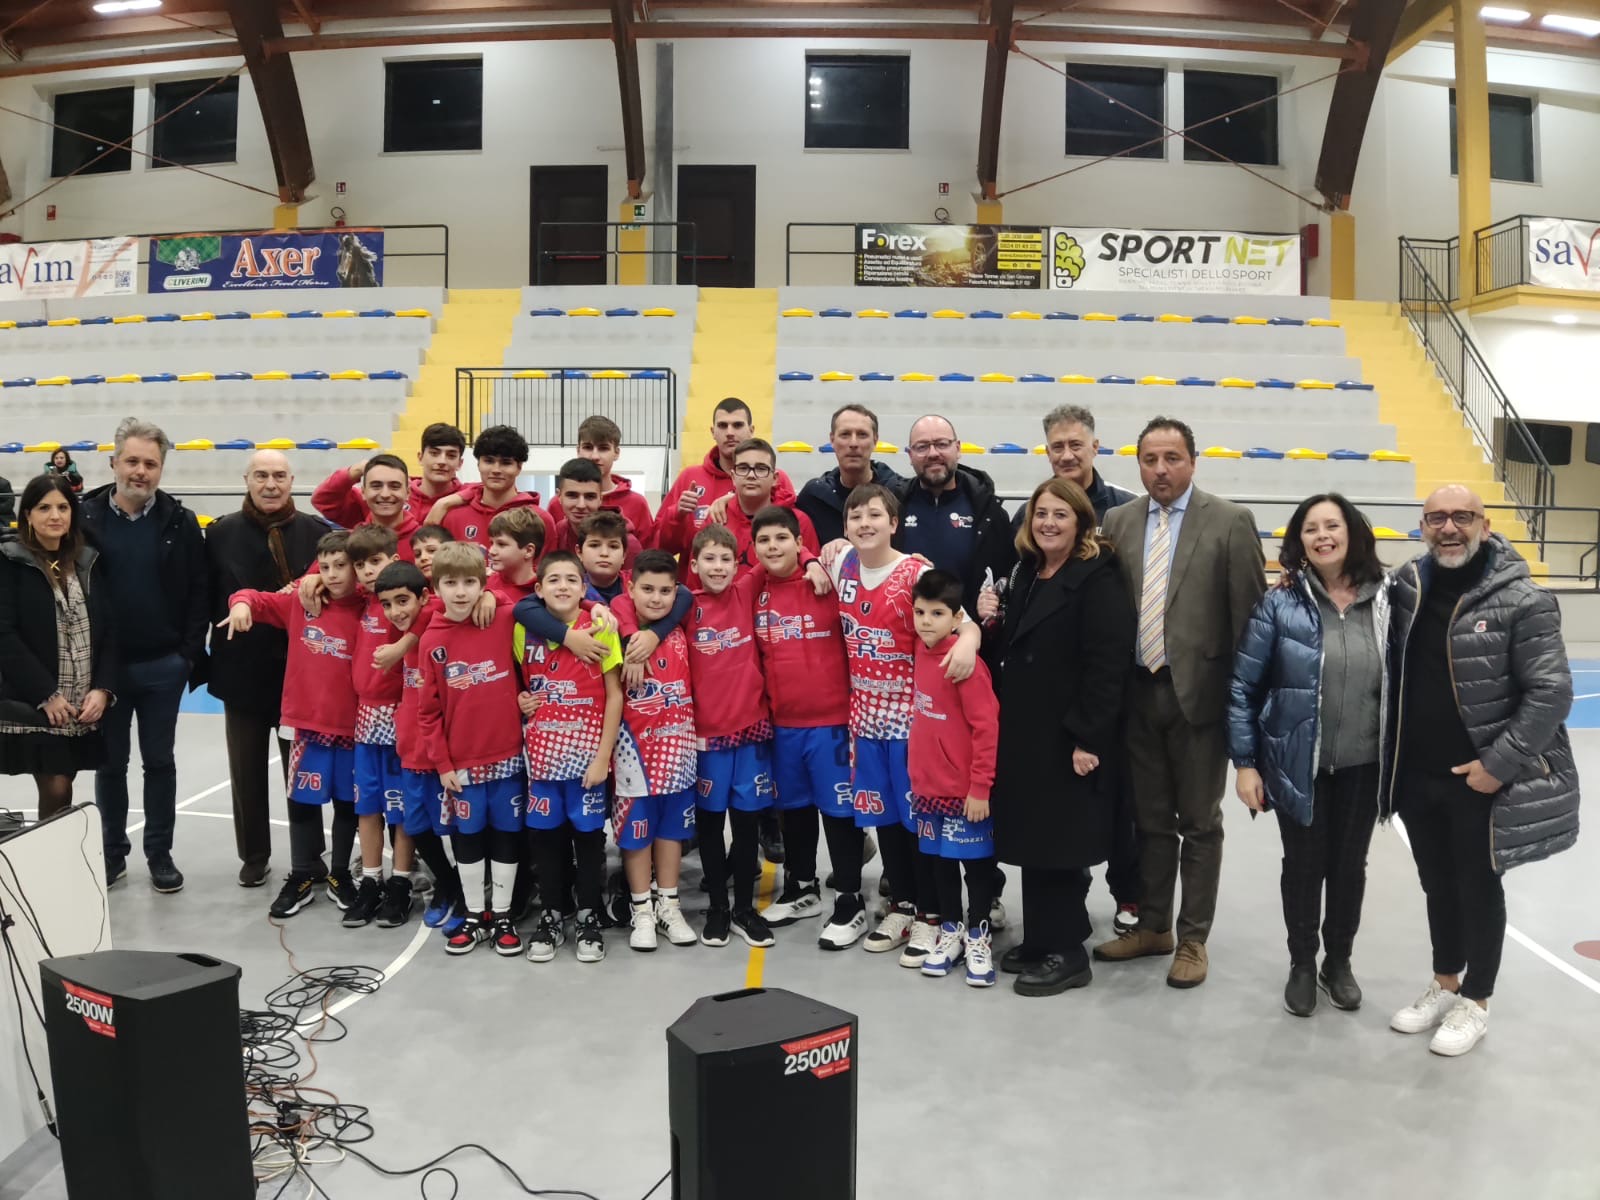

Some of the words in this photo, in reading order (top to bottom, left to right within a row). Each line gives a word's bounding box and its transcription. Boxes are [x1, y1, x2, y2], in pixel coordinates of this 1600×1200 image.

[862, 228, 927, 251] Forex
[1098, 232, 1222, 265] SPORT
[1224, 236, 1295, 266] NET
[230, 238, 321, 278] Axer
[1118, 266, 1188, 279] SPECIALISTI
[1192, 268, 1231, 279] DELLO
[1232, 269, 1273, 281] SPORT
[526, 645, 546, 664] 74
[297, 771, 321, 791] 76
[527, 794, 550, 817] 74
[854, 789, 885, 815] 45
[631, 818, 648, 840] 11
[65, 993, 114, 1026] 2500W
[784, 1037, 851, 1076] 2500W
